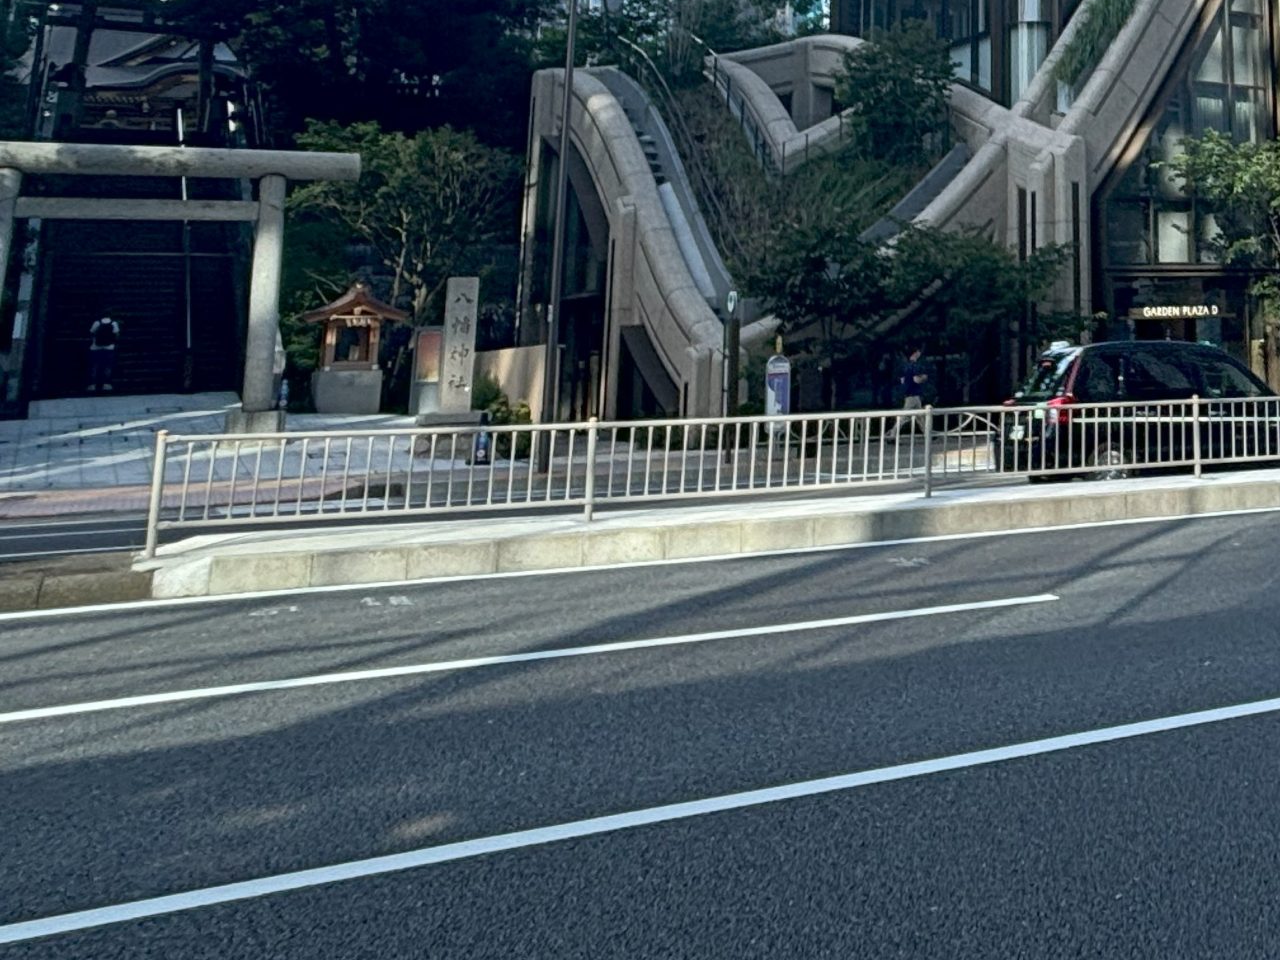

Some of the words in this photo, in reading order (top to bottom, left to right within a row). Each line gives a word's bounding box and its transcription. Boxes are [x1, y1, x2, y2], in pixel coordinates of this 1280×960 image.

[1143, 306, 1180, 317] GARDEN
[1182, 305, 1209, 316] PLAZA
[1211, 304, 1219, 315] D
[448, 292, 474, 389] 八幡神社
